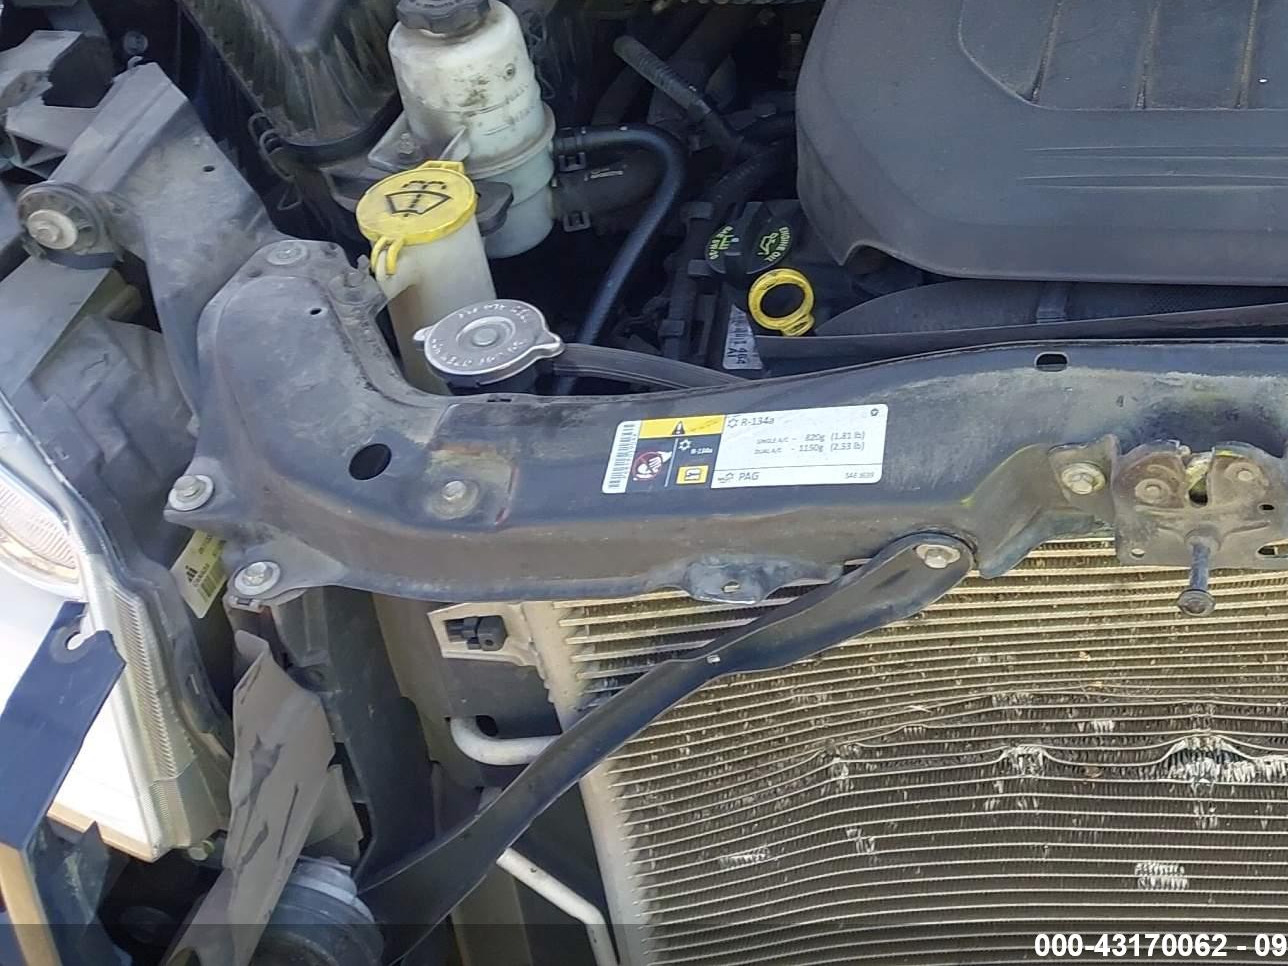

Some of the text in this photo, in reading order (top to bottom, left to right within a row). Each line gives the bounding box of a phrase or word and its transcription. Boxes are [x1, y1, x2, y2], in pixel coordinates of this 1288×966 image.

[763, 226, 791, 263] ENGINE OIL
[740, 416, 775, 426] R-134a
[738, 471, 760, 481] PAG
